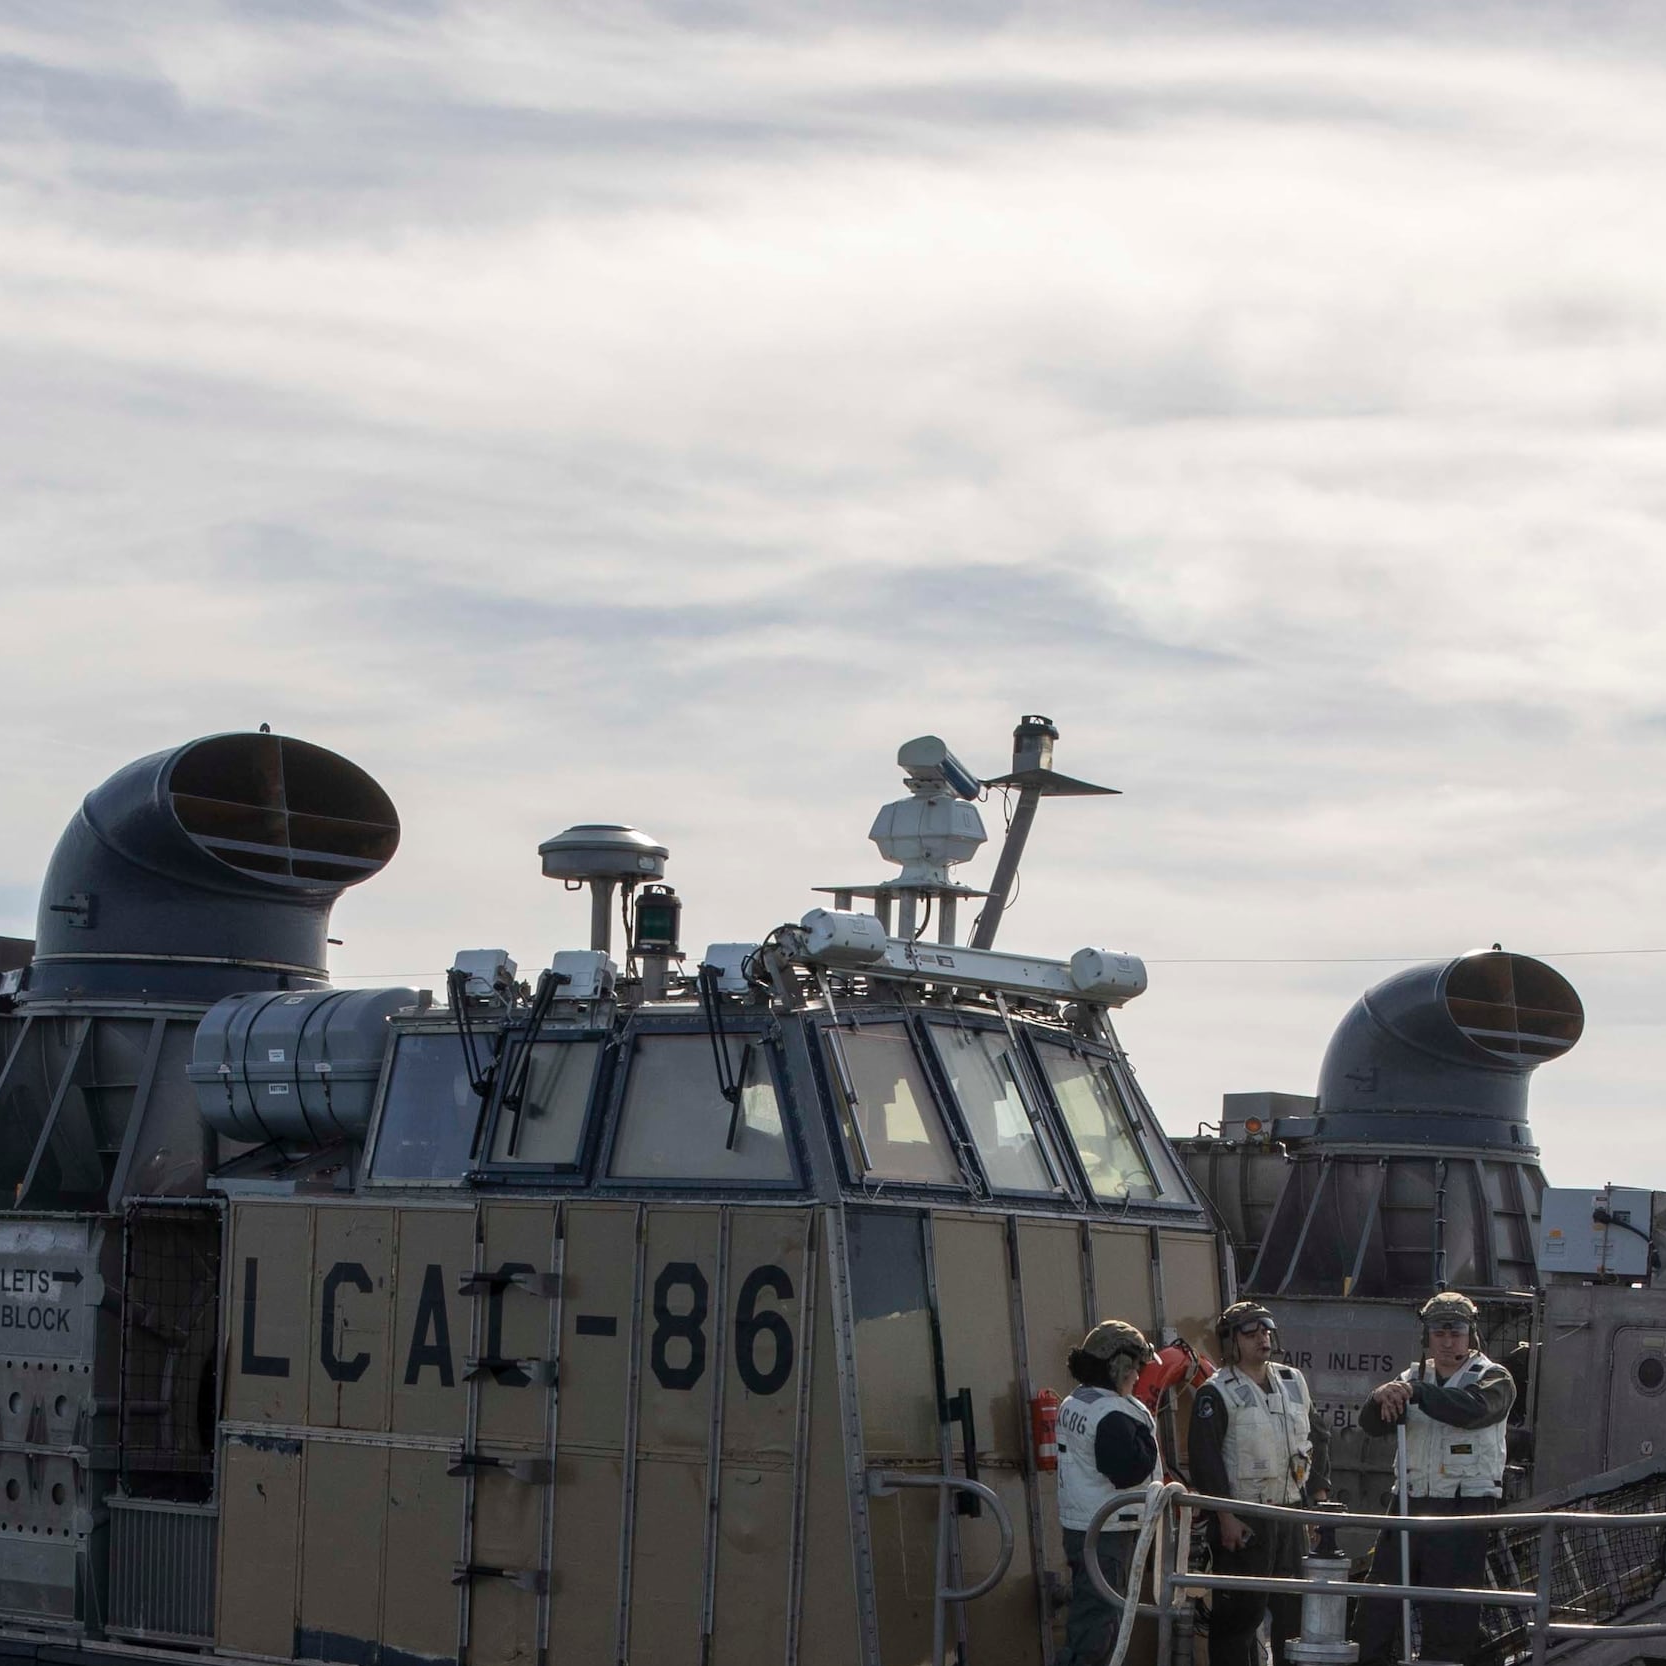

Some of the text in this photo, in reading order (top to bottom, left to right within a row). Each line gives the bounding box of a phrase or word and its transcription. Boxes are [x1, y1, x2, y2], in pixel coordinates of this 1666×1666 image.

[1, 1305, 71, 1333] BLOCK
[240, 1256, 794, 1395] LCAC-86
[1283, 1351, 1394, 1372] AIR INLETS
